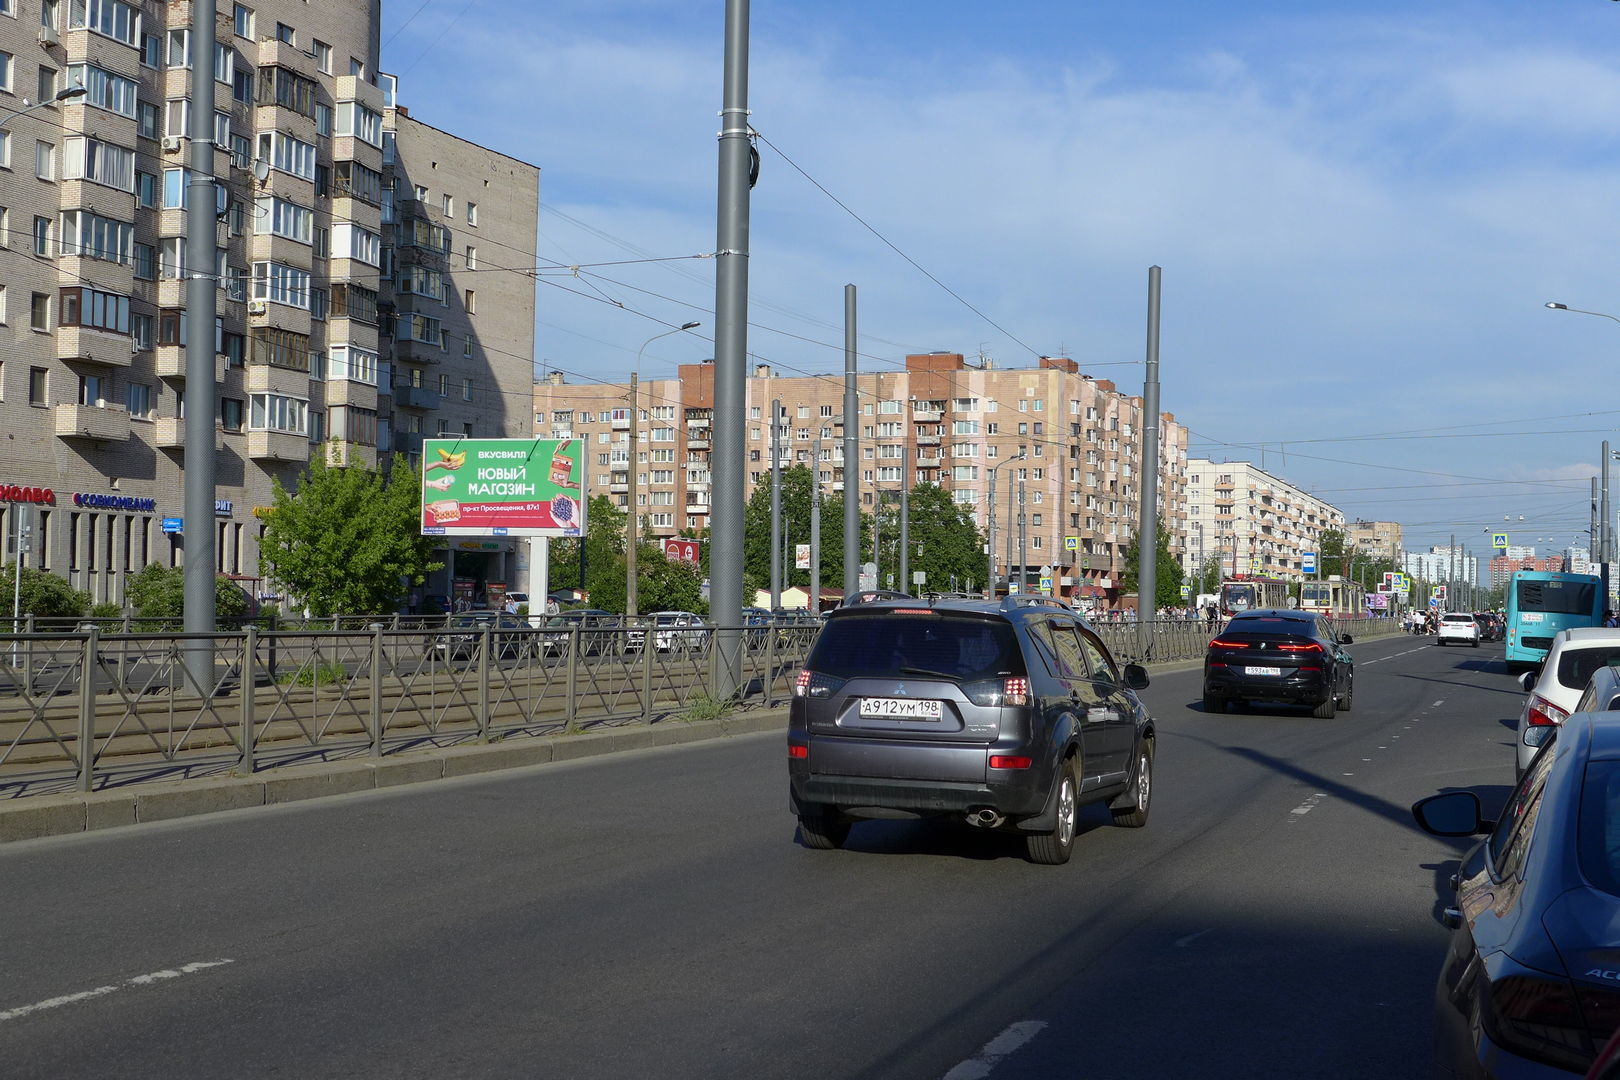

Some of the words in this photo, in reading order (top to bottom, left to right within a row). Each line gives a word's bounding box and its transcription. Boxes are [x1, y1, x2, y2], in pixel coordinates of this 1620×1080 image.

[478, 451, 526, 459] ВКУСВИЛЛ
[477, 465, 526, 480] НОВЫЙ
[864, 700, 915, 714] А912УМ
[918, 701, 938, 712] 198
